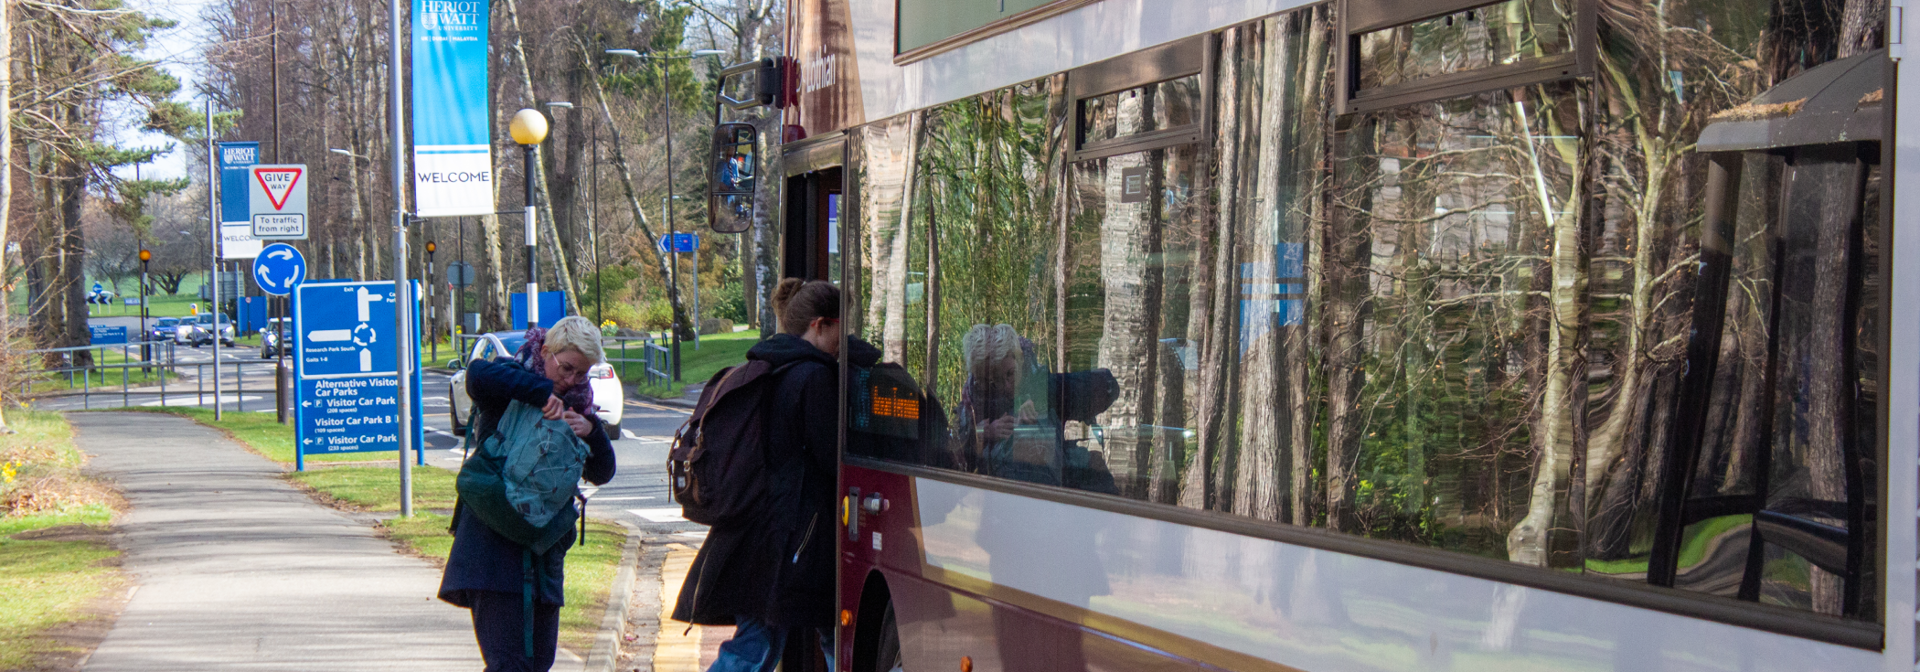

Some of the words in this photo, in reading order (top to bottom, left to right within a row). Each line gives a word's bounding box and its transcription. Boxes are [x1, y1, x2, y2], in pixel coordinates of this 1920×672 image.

[421, 0, 480, 12] HERIOT
[439, 13, 480, 24] WATT
[806, 44, 836, 93] Lothian
[264, 173, 290, 182] GIVE
[417, 171, 490, 183] WELCOME
[280, 225, 299, 233] right
[315, 379, 367, 389] Alternative
[368, 378, 398, 387] Visitor
[315, 388, 331, 397] Car
[333, 387, 358, 396] Parks
[326, 399, 357, 407] Visitor
[358, 397, 374, 406] Car
[375, 396, 396, 405] Park
[315, 418, 344, 426] Visitor
[346, 416, 361, 425] Car
[363, 415, 383, 424] Park
[385, 415, 391, 423] B
[328, 436, 358, 444] Visitor
[360, 435, 375, 443] Car
[377, 434, 397, 442] Park
